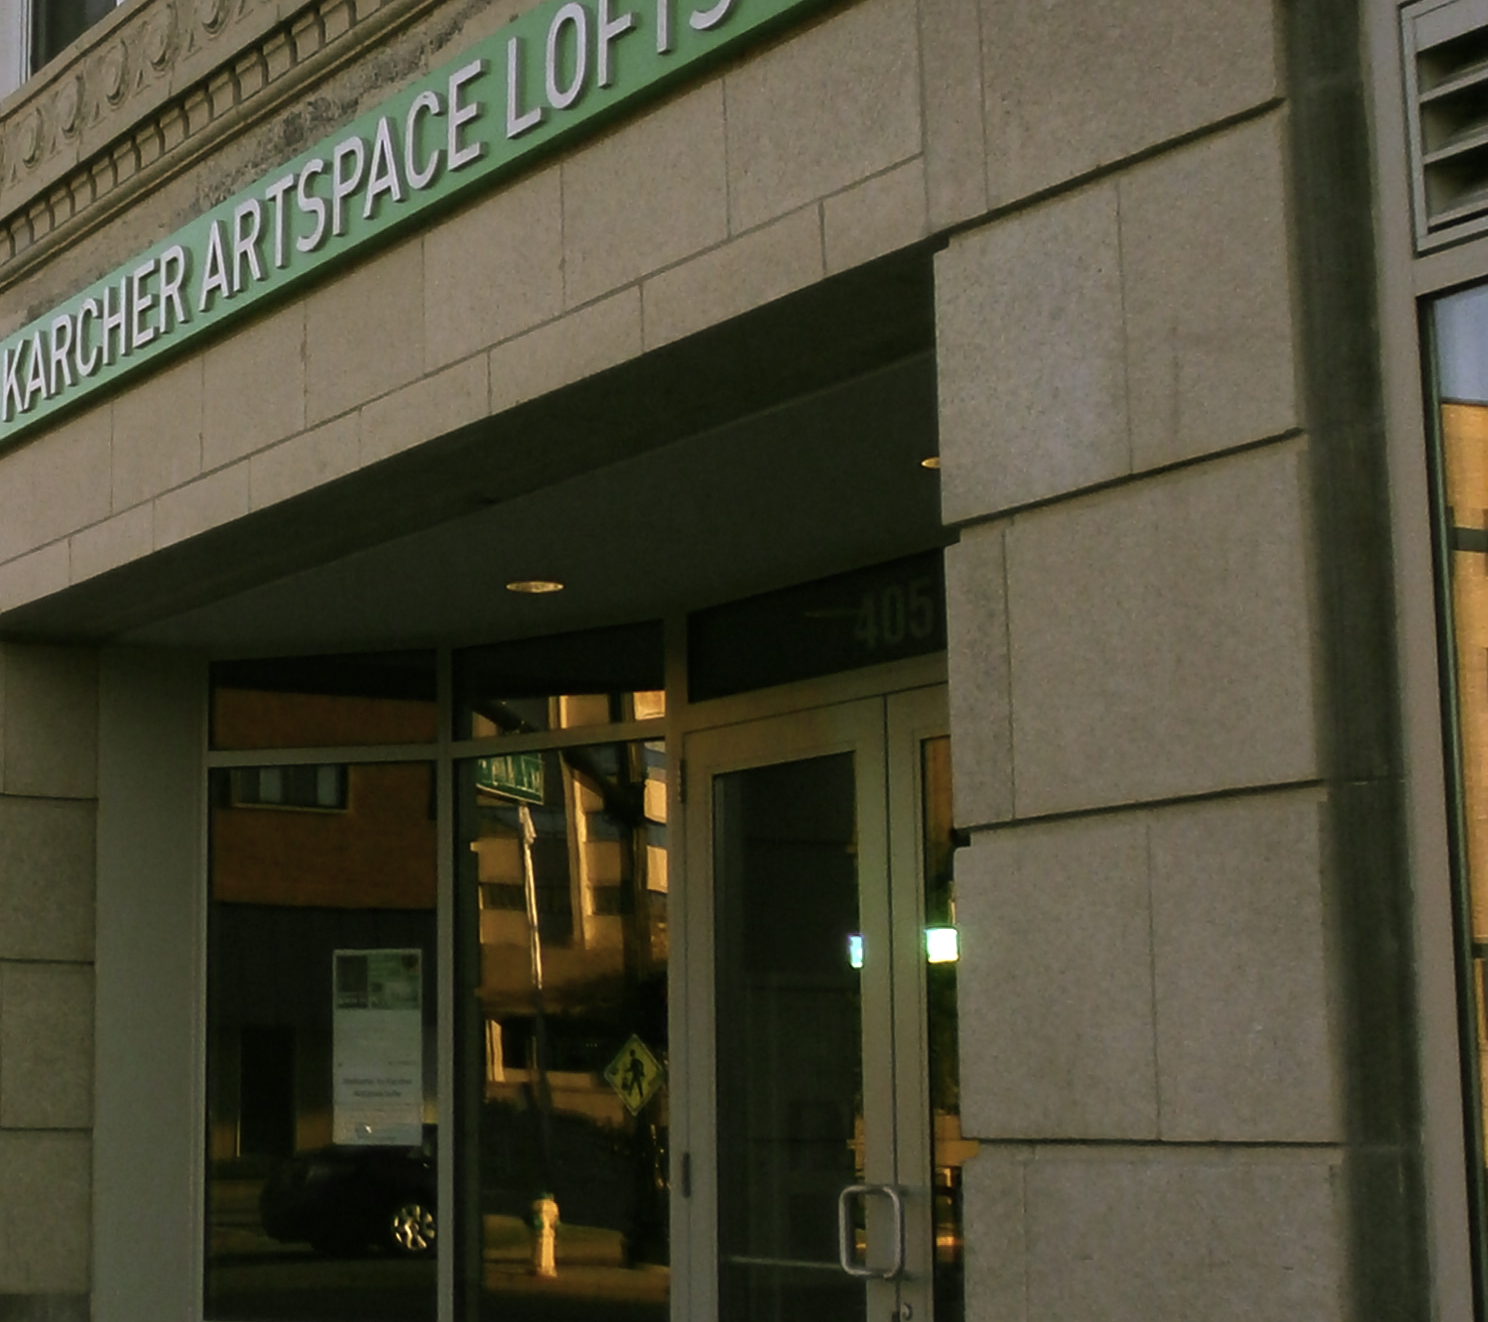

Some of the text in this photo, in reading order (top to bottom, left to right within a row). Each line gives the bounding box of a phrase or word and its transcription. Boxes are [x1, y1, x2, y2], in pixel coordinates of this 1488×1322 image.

[1, 244, 190, 422] KARCHER
[198, 58, 488, 312] ARTSPACE
[853, 576, 934, 649] 405
